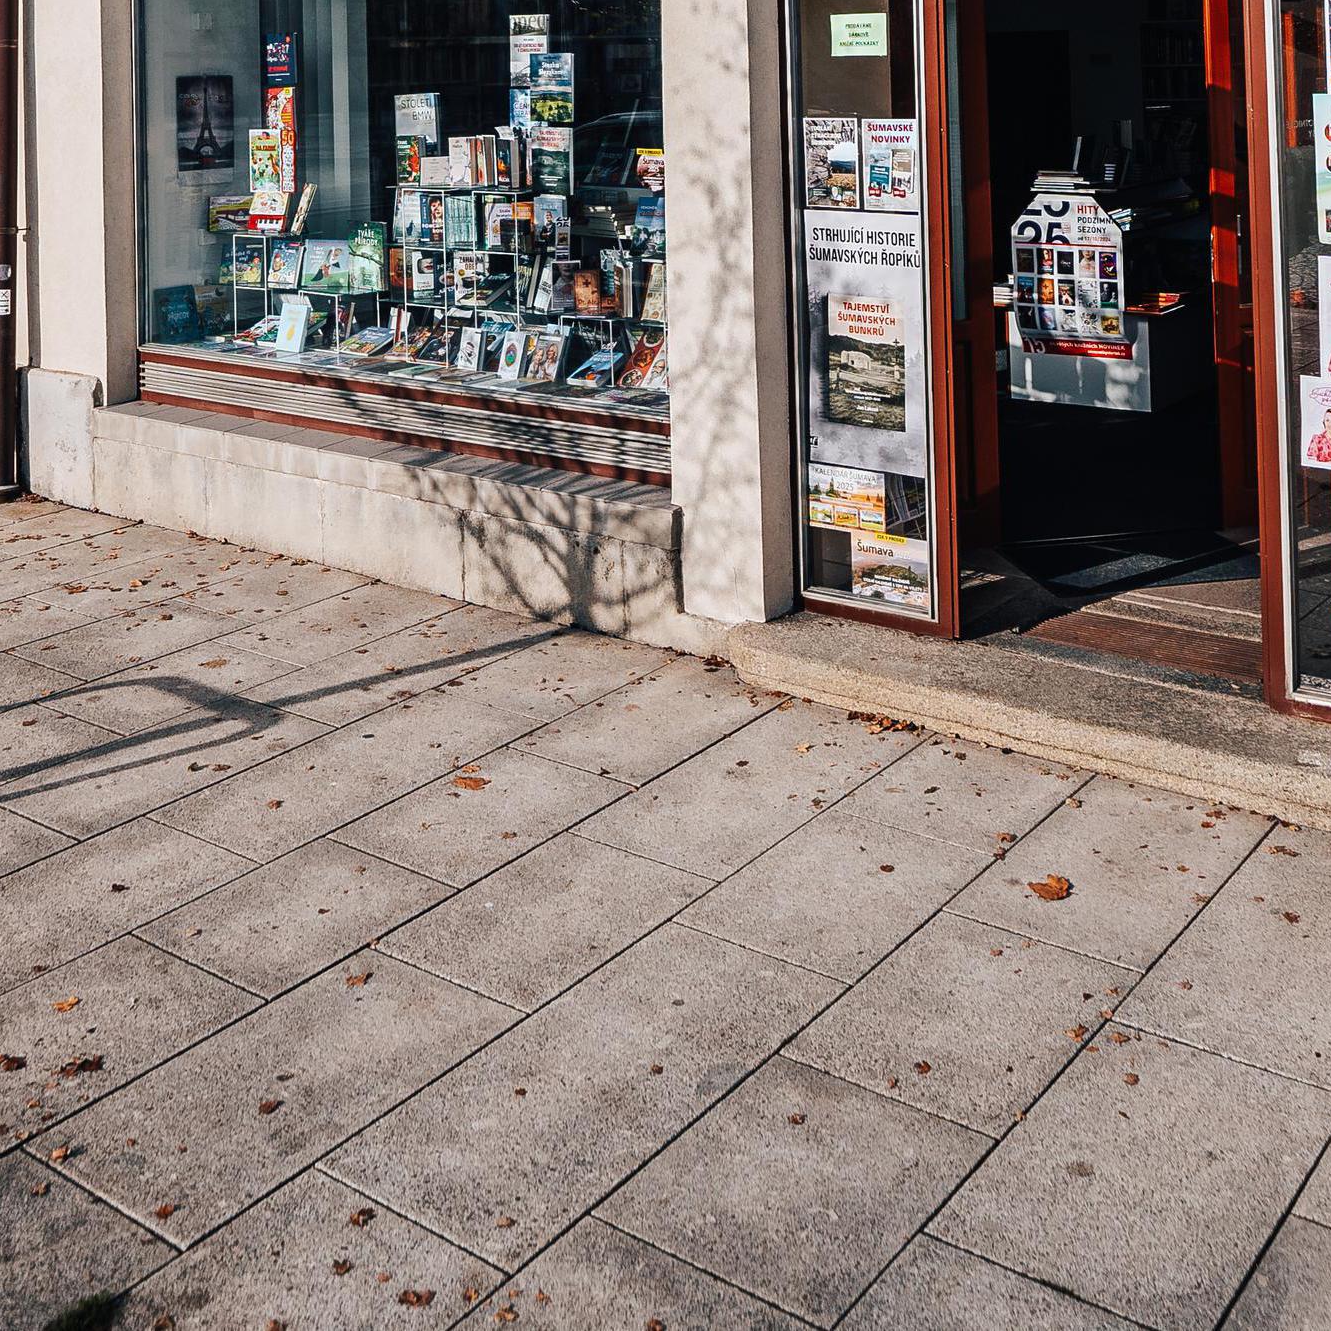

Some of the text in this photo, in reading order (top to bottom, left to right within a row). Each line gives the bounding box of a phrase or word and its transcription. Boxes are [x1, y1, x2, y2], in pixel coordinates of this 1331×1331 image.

[412, 110, 433, 121] BMW
[867, 121, 914, 133] ŠUMAVSKÉ
[871, 135, 911, 144] NOVINKY
[1077, 205, 1100, 215] HITY
[812, 226, 916, 247] STRHUJÍCÍ HISTORIE
[809, 244, 921, 269] ŠUMAVSKÝCH ŘOPÍKŮ
[842, 301, 890, 314] TAJEMSTVÍ
[837, 311, 896, 326] ŠUMAVSKÝCH
[848, 325, 885, 336] BUNKRŮ
[856, 538, 894, 557] Šumava
